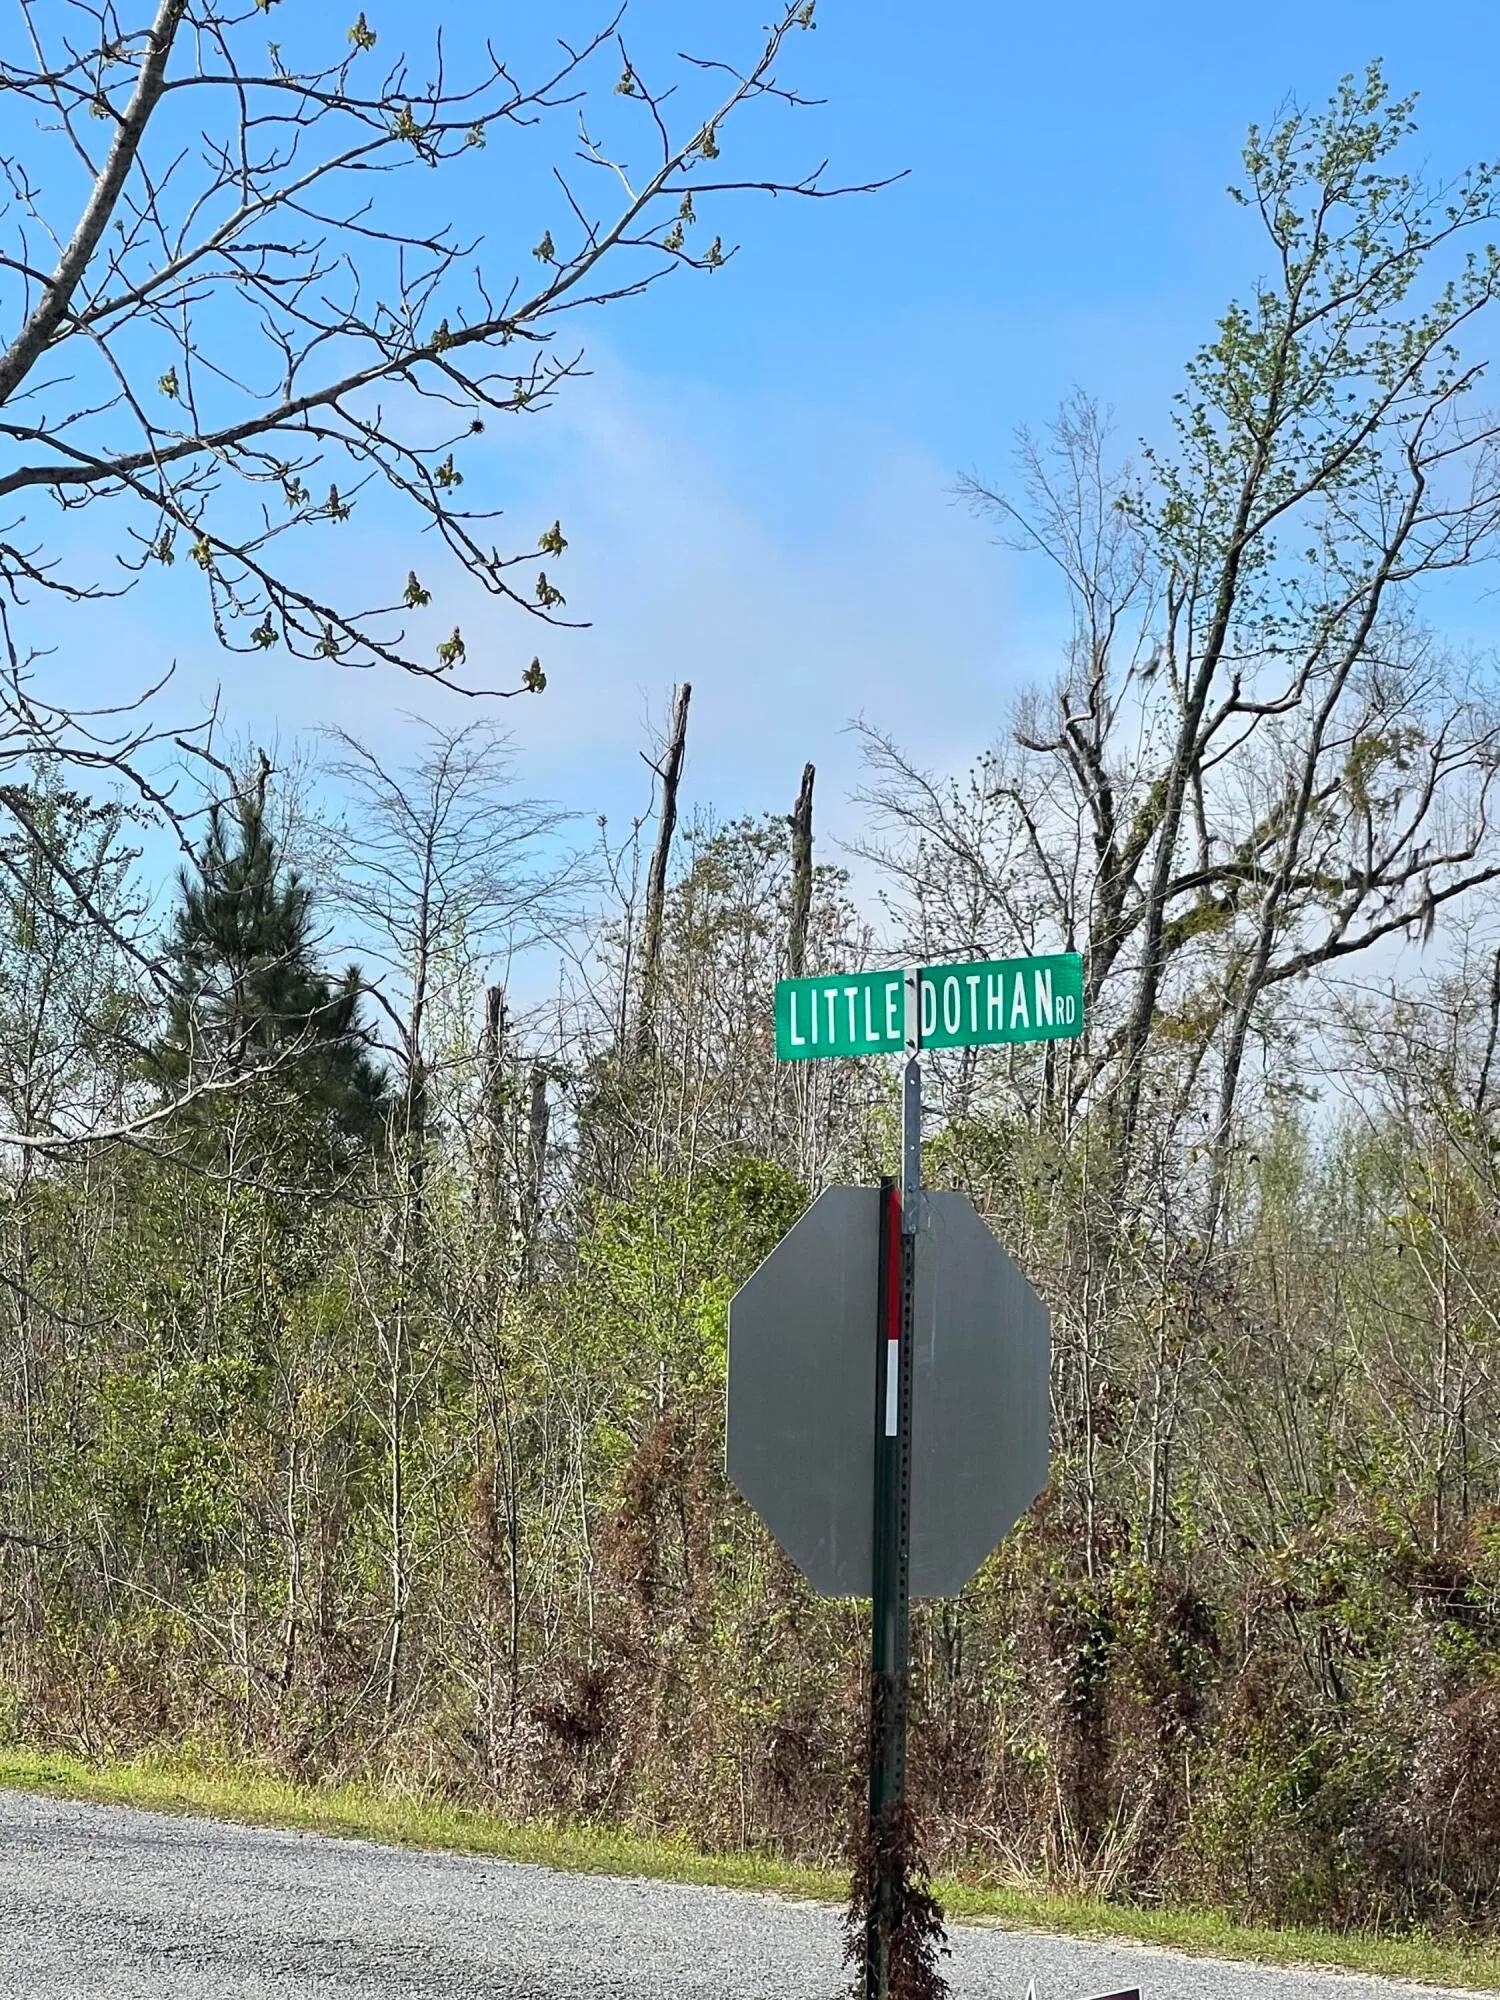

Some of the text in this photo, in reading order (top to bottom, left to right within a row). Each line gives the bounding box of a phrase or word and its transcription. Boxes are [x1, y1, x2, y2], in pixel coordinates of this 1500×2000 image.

[790, 969, 1076, 1045] LITTLE DOTHAN RD
